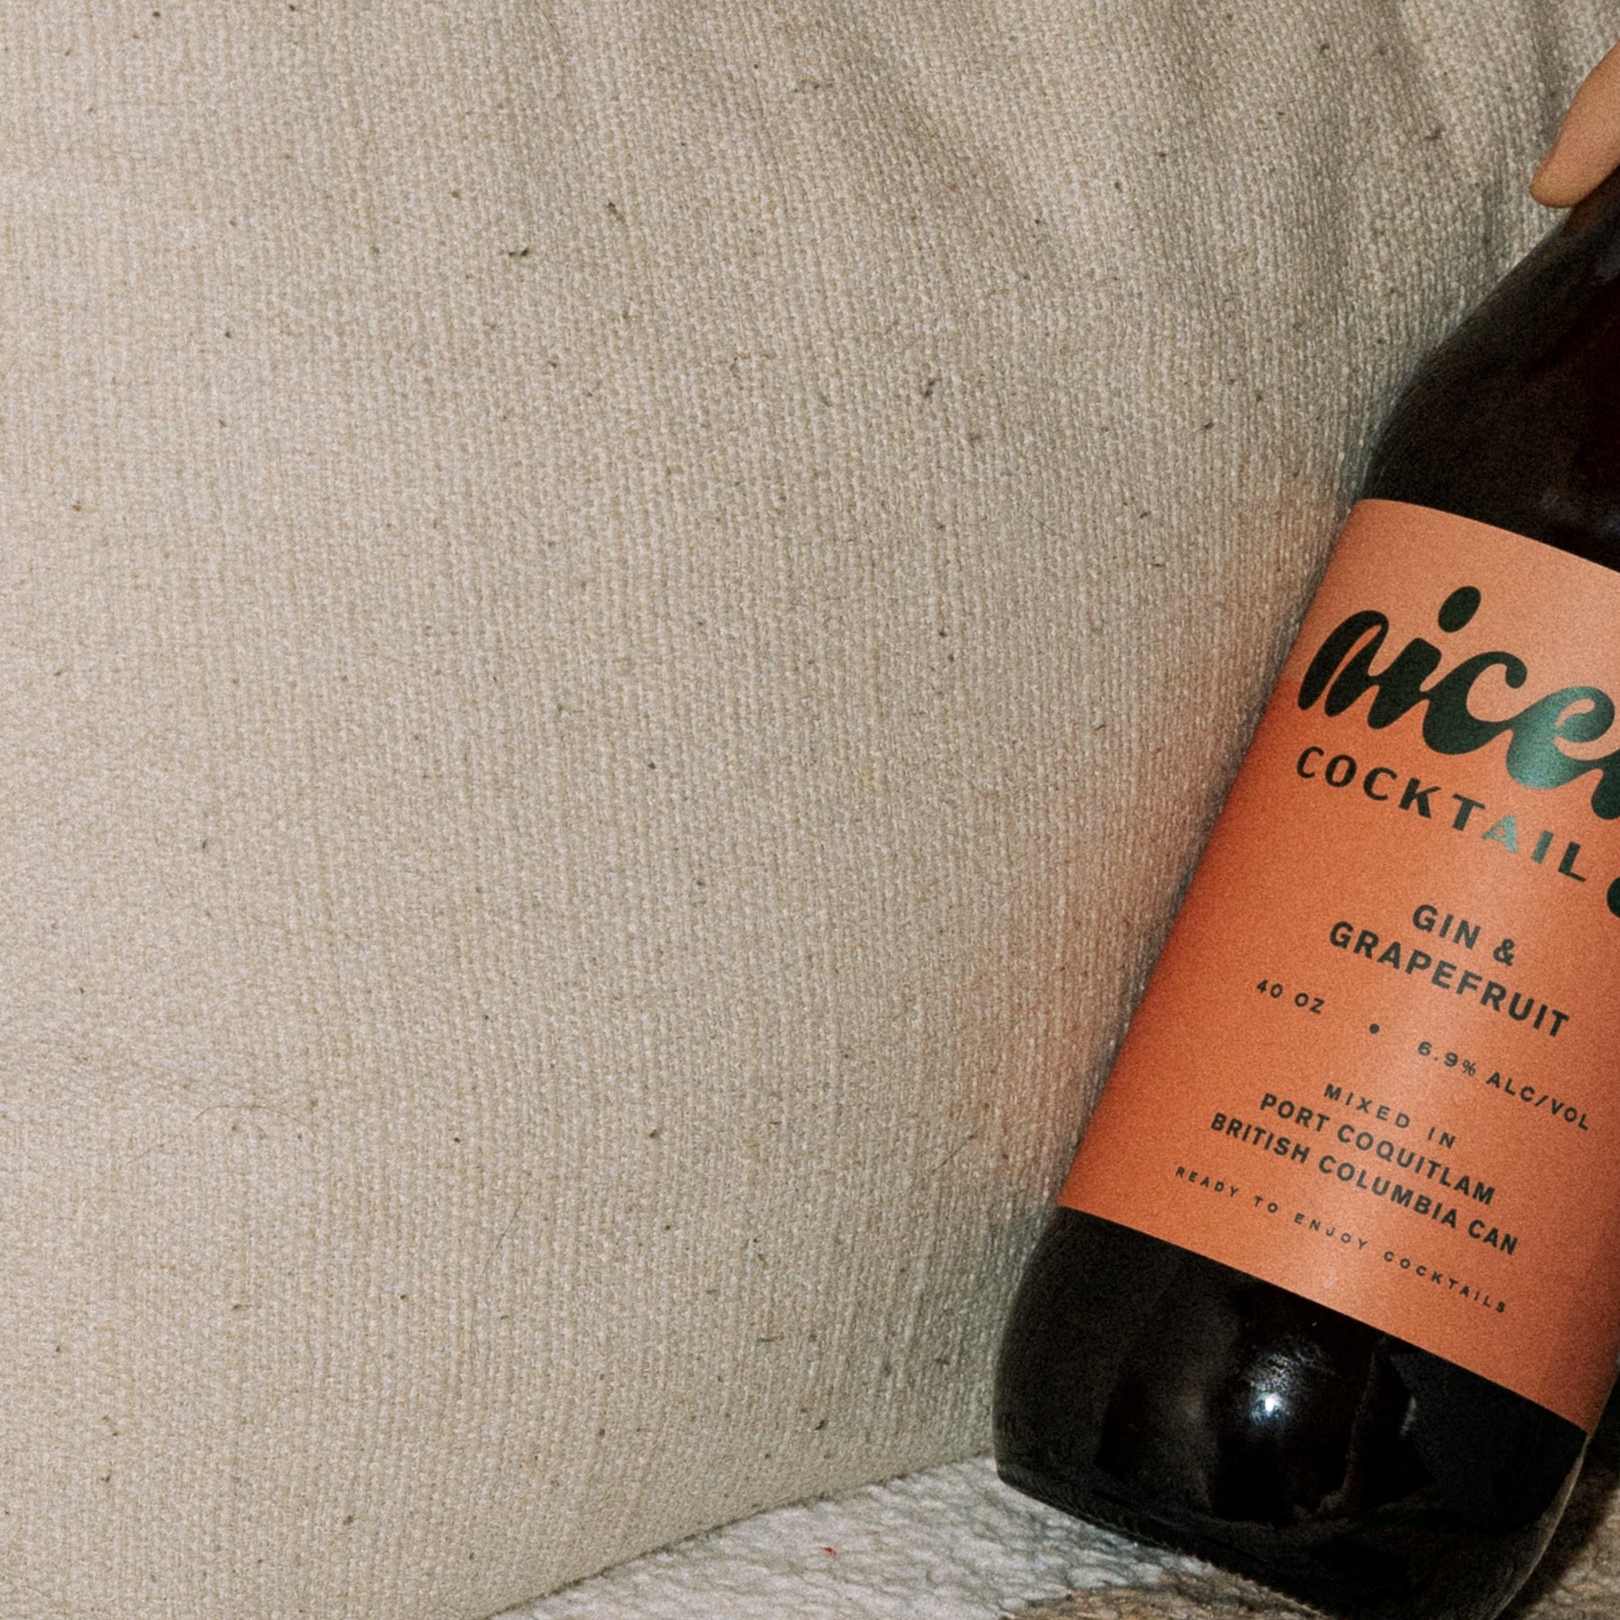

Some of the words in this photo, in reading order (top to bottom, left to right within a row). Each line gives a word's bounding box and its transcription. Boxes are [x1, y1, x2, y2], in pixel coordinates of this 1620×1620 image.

[1296, 746, 1587, 883] COCKTAIL
[1329, 920, 1570, 1038] GRAPEFRUIT
[1412, 904, 1481, 950] GIN
[1493, 938, 1516, 966] &
[1256, 979, 1283, 999] 40
[1294, 992, 1325, 1014] OZ
[1418, 1041, 1477, 1077] 6.9%
[1486, 1071, 1590, 1131] ALC/VOL
[1324, 1084, 1411, 1129] MIXED
[1428, 1127, 1457, 1149] IN
[1210, 1112, 1310, 1163] BRITISH
[1318, 1155, 1458, 1229] COLUMBIA
[1467, 1219, 1518, 1256] CAN
[1260, 1093, 1330, 1133] PORT
[1337, 1124, 1496, 1207] COQUITLAM
[1175, 1166, 1239, 1197] READY
[1254, 1195, 1279, 1214] TO
[1294, 1213, 1367, 1249] ENJOY
[1383, 1250, 1507, 1314] COCKTAILS
